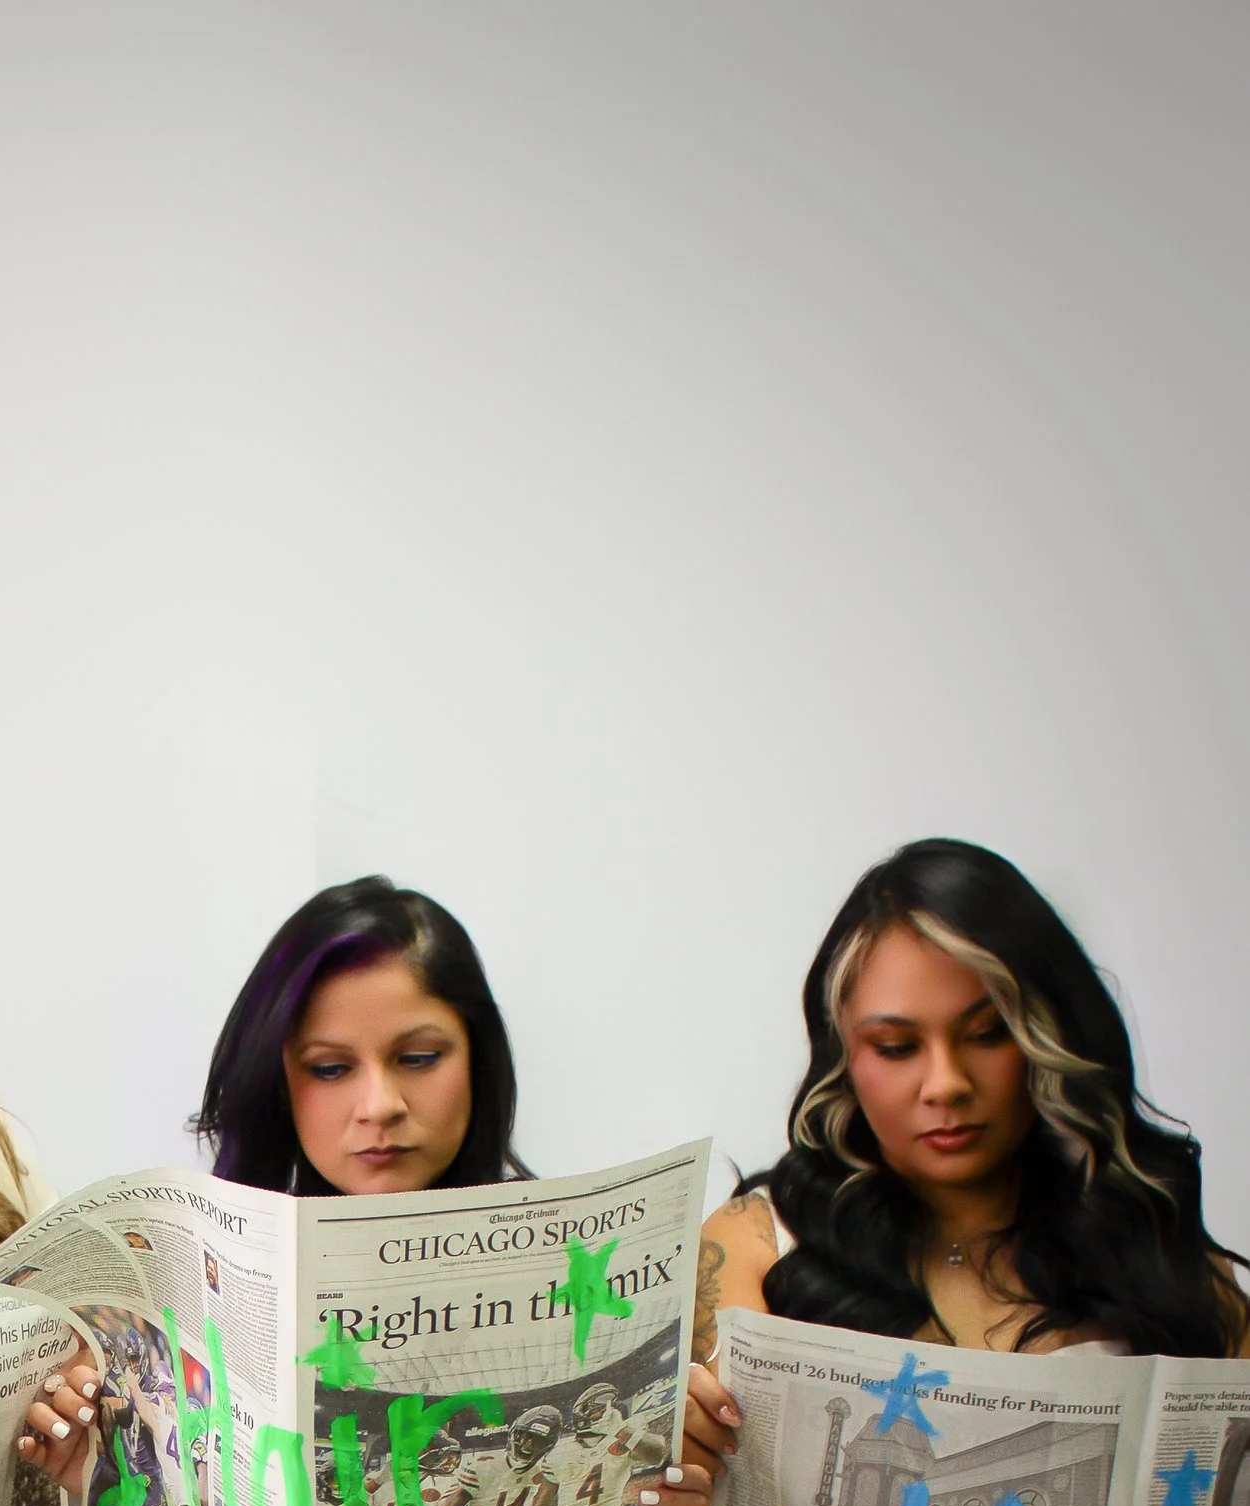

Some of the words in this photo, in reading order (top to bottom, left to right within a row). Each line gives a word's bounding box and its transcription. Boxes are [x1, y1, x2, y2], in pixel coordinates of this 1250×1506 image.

[0, 1199, 108, 1259] NATIONAL
[107, 1186, 186, 1204] SPORTS
[186, 1192, 248, 1235] REPORT
[489, 1213, 524, 1224] Chicago
[526, 1208, 559, 1220] Tribune
[378, 1226, 535, 1264] CHICAGO
[542, 1198, 647, 1247] SPORTS
[316, 1292, 343, 1300] BEARS
[470, 1292, 514, 1328] in
[21, 1317, 62, 1340] Holiday,
[20, 1348, 34, 1365] the
[38, 1342, 60, 1359] Gift
[60, 1334, 72, 1351] of
[19, 1371, 38, 1389] that
[730, 1346, 800, 1374] Proposed
[934, 1388, 998, 1411] funding
[1001, 1396, 1026, 1411] for
[1029, 1399, 1121, 1415] Paramount
[1162, 1403, 1198, 1412] should
[1200, 1402, 1213, 1411] be
[1215, 1402, 1237, 1411] able
[1164, 1392, 1190, 1402] Pope
[1194, 1392, 1215, 1401] says
[244, 1411, 254, 1430] 10
[465, 1425, 509, 1436] allegiant
[575, 1463, 604, 1505] 4
